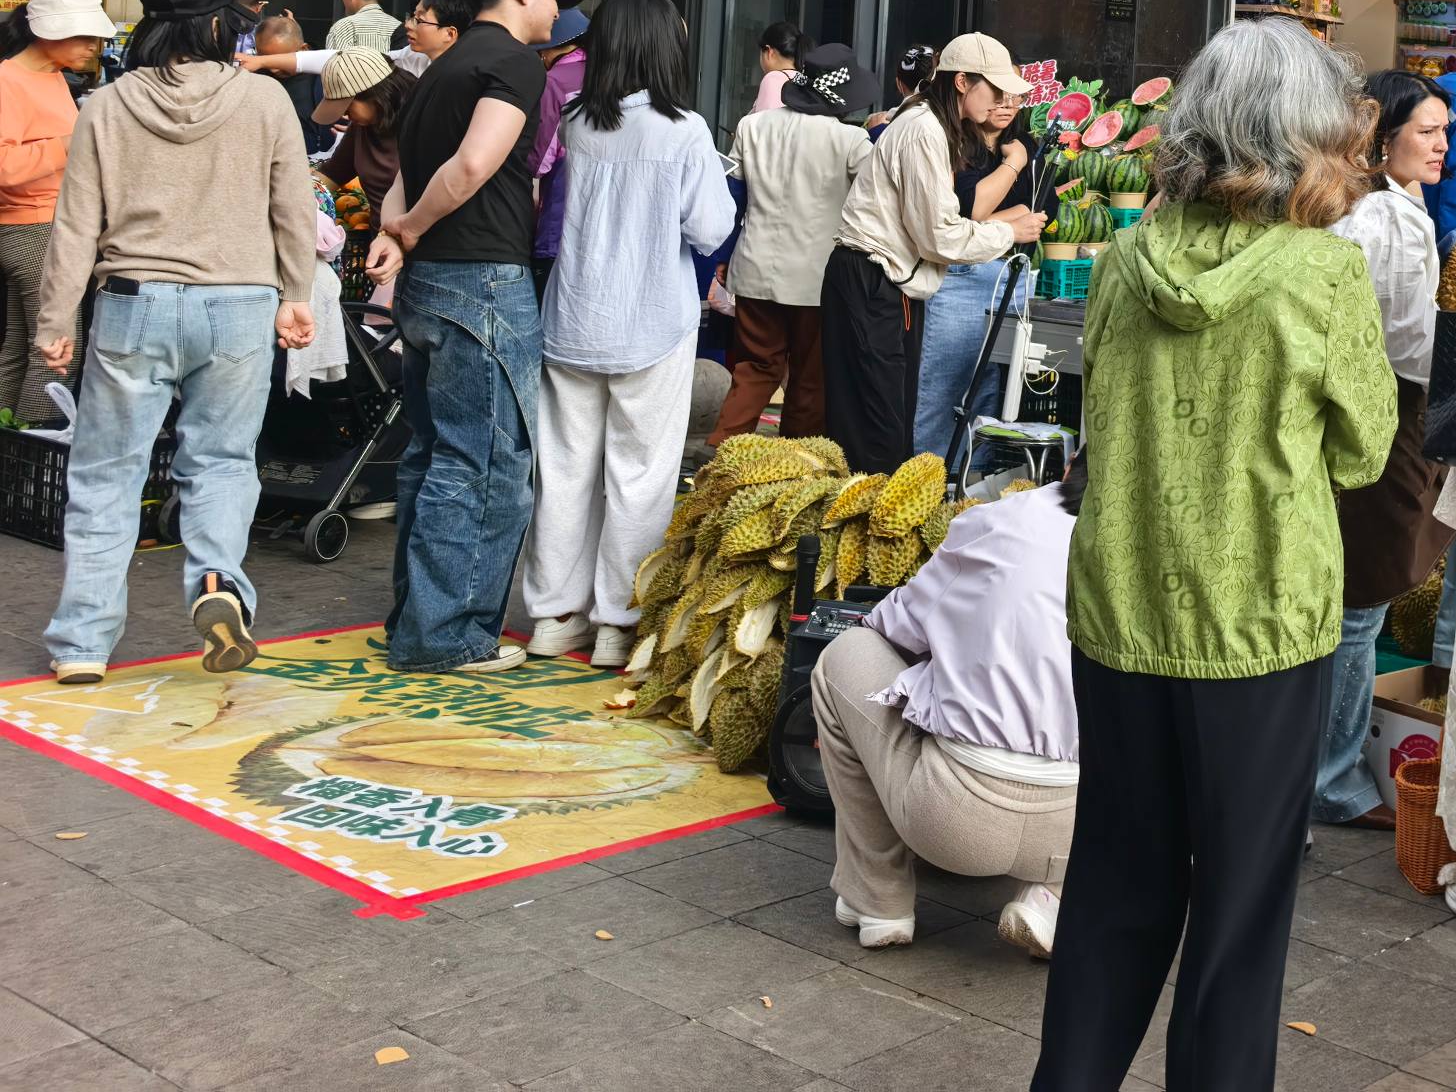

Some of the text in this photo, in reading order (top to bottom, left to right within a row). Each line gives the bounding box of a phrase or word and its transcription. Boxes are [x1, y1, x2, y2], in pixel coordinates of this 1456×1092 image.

[1021, 61, 1056, 84] 酷暑
[296, 777, 507, 827] 榴香入骨
[279, 803, 498, 856] 回味入心
